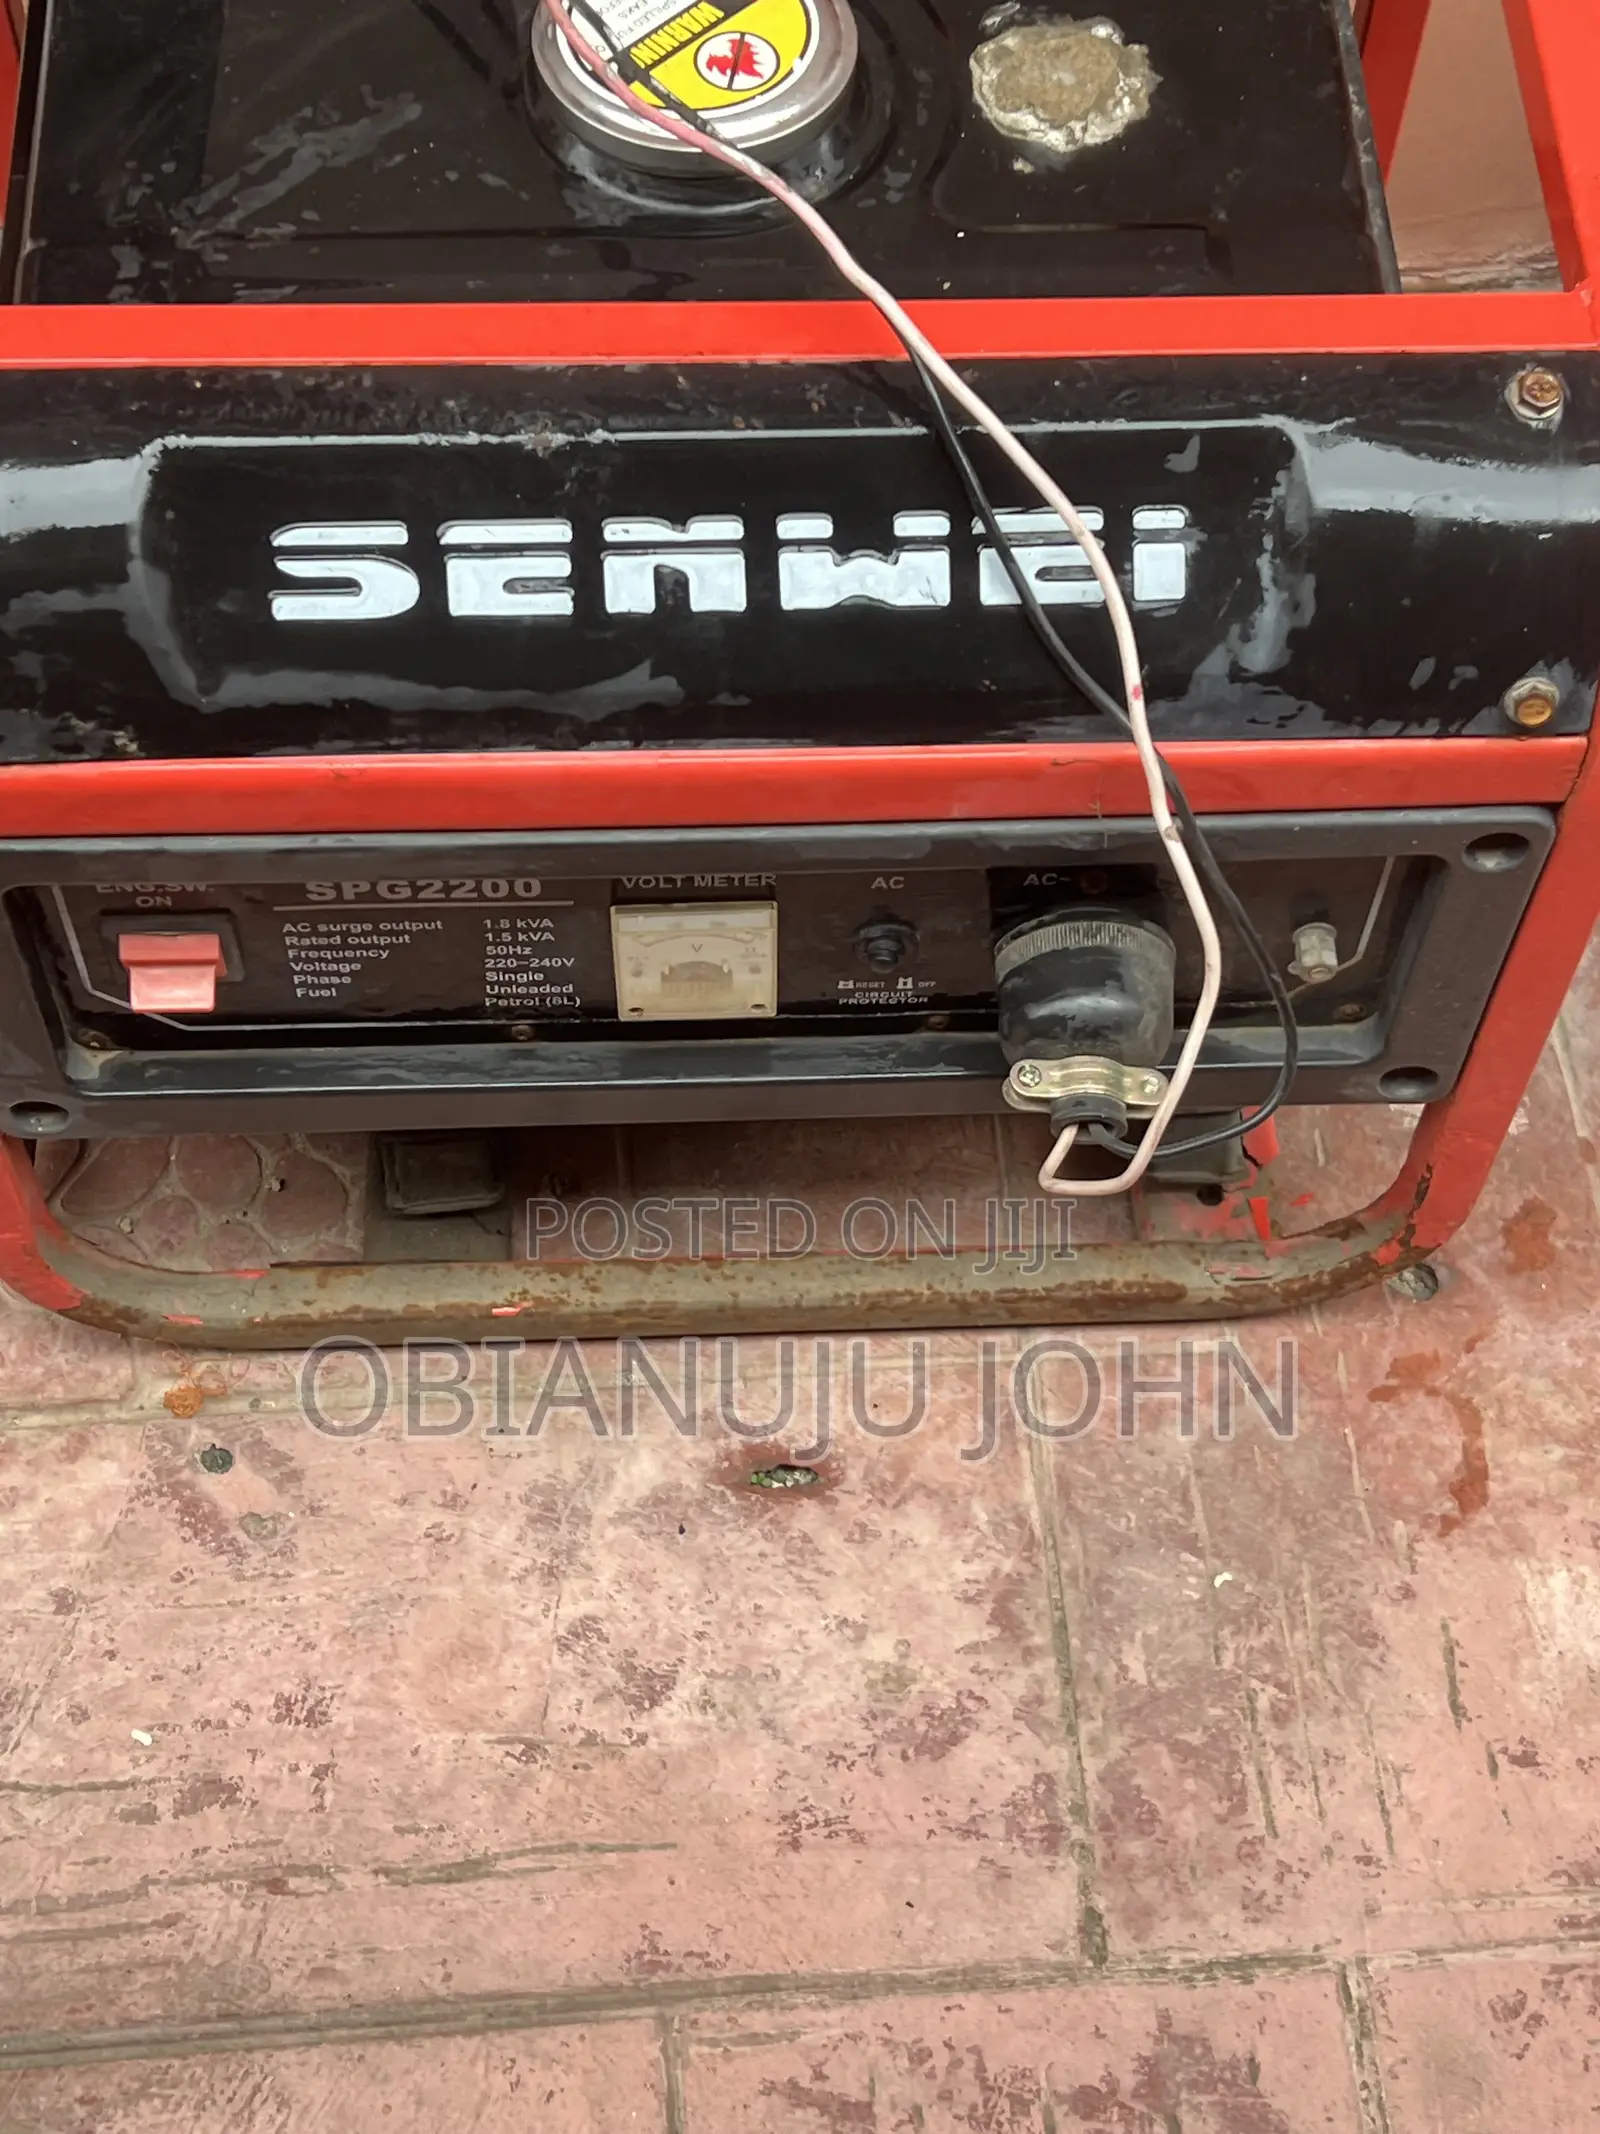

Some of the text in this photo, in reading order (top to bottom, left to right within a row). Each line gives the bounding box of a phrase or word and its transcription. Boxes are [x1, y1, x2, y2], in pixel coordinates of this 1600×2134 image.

[629, 0, 725, 69] WARNIN
[620, 873, 777, 890] VOLT METER
[870, 876, 905, 889] AC
[305, 877, 542, 900] SPG2200
[135, 896, 173, 908] ON
[282, 920, 443, 934] AC surge output
[483, 918, 554, 930] 1.8 kVA
[284, 934, 411, 946] Rated output
[484, 931, 555, 943] 1.5 kVA
[287, 949, 390, 960] Frequency
[486, 945, 533, 955] 50Hz
[289, 961, 362, 973] Voltage
[292, 974, 352, 985] Phase
[485, 970, 544, 983] Single
[295, 987, 337, 998] Fuel
[485, 983, 574, 995] Unleaded
[854, 991, 913, 999] CIRCUIT
[485, 997, 540, 1007] Petrol
[838, 997, 929, 1005] PROTECTOR
